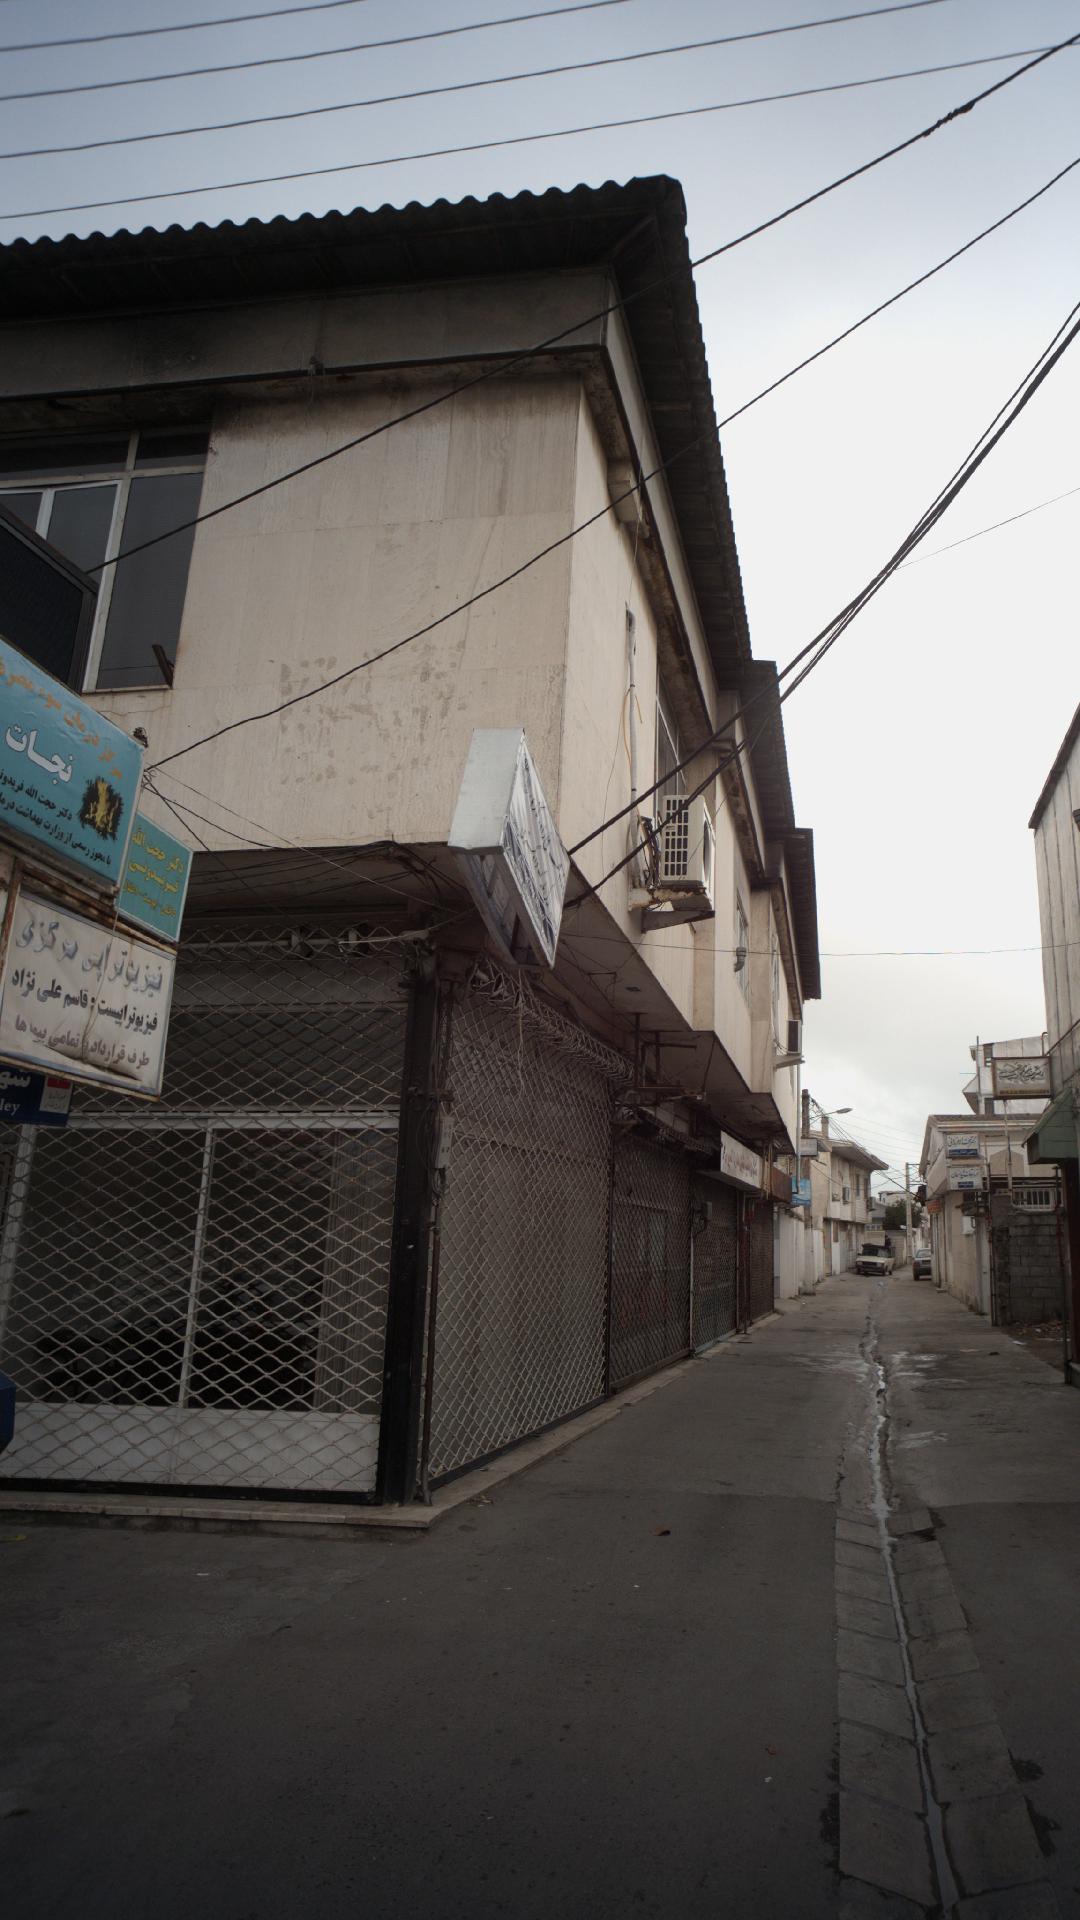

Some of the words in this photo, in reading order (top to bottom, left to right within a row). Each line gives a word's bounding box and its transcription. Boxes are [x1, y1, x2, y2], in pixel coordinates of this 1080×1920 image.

[5, 725, 73, 785] نجات
[0, 768, 25, 793] فریدون
[0, 791, 15, 810] درما
[25, 784, 38, 801] الله
[16, 804, 42, 826] بهداشت
[56, 808, 73, 820] دکتر
[43, 820, 64, 841] وزارت
[64, 832, 73, 844] از
[106, 855, 112, 865] با
[16, 921, 79, 962] مرکزی
[12, 968, 36, 997] نژاد
[37, 979, 62, 1003] علی
[63, 989, 88, 1009] قاسم
[15, 1015, 27, 1032] ها
[127, 1049, 150, 1069] طرف
[0, 1098, 20, 1116] ley
